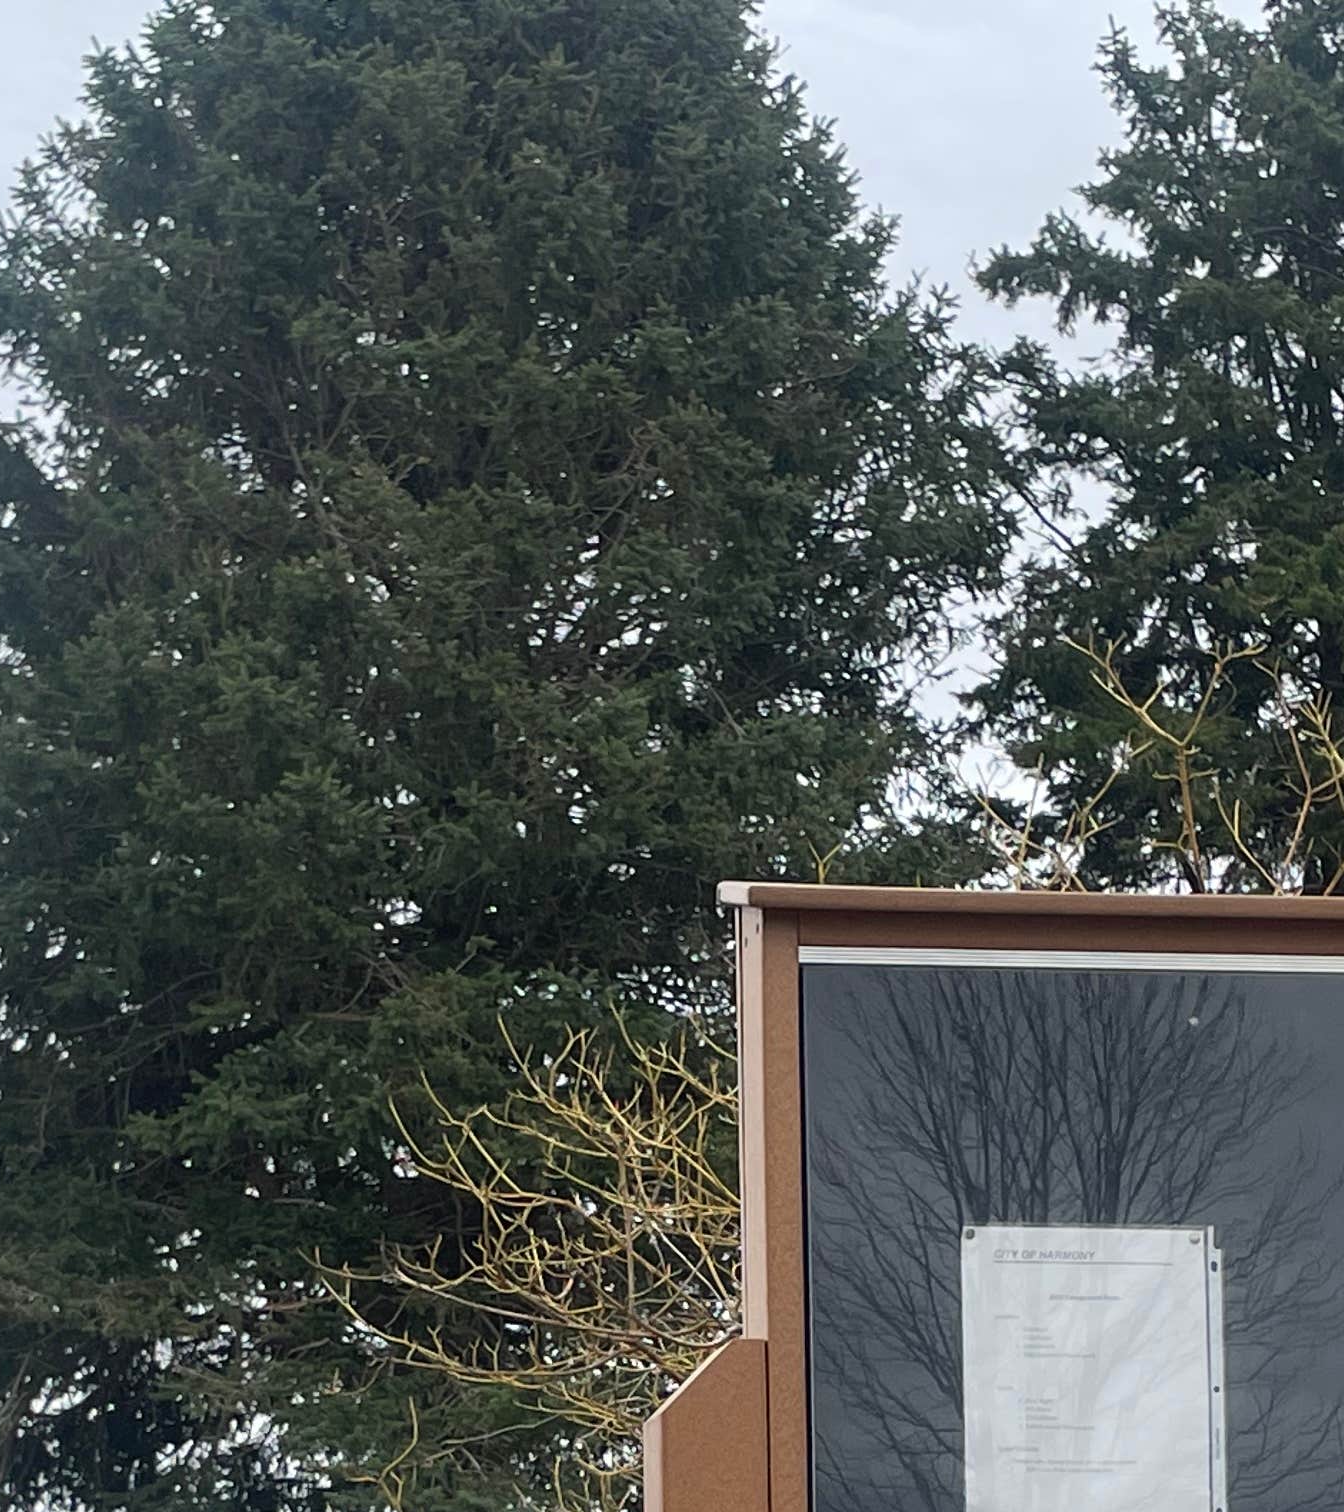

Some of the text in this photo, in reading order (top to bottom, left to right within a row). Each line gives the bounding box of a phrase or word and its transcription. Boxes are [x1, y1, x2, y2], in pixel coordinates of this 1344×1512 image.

[994, 1249, 1096, 1261] CITY OF HARMONY
